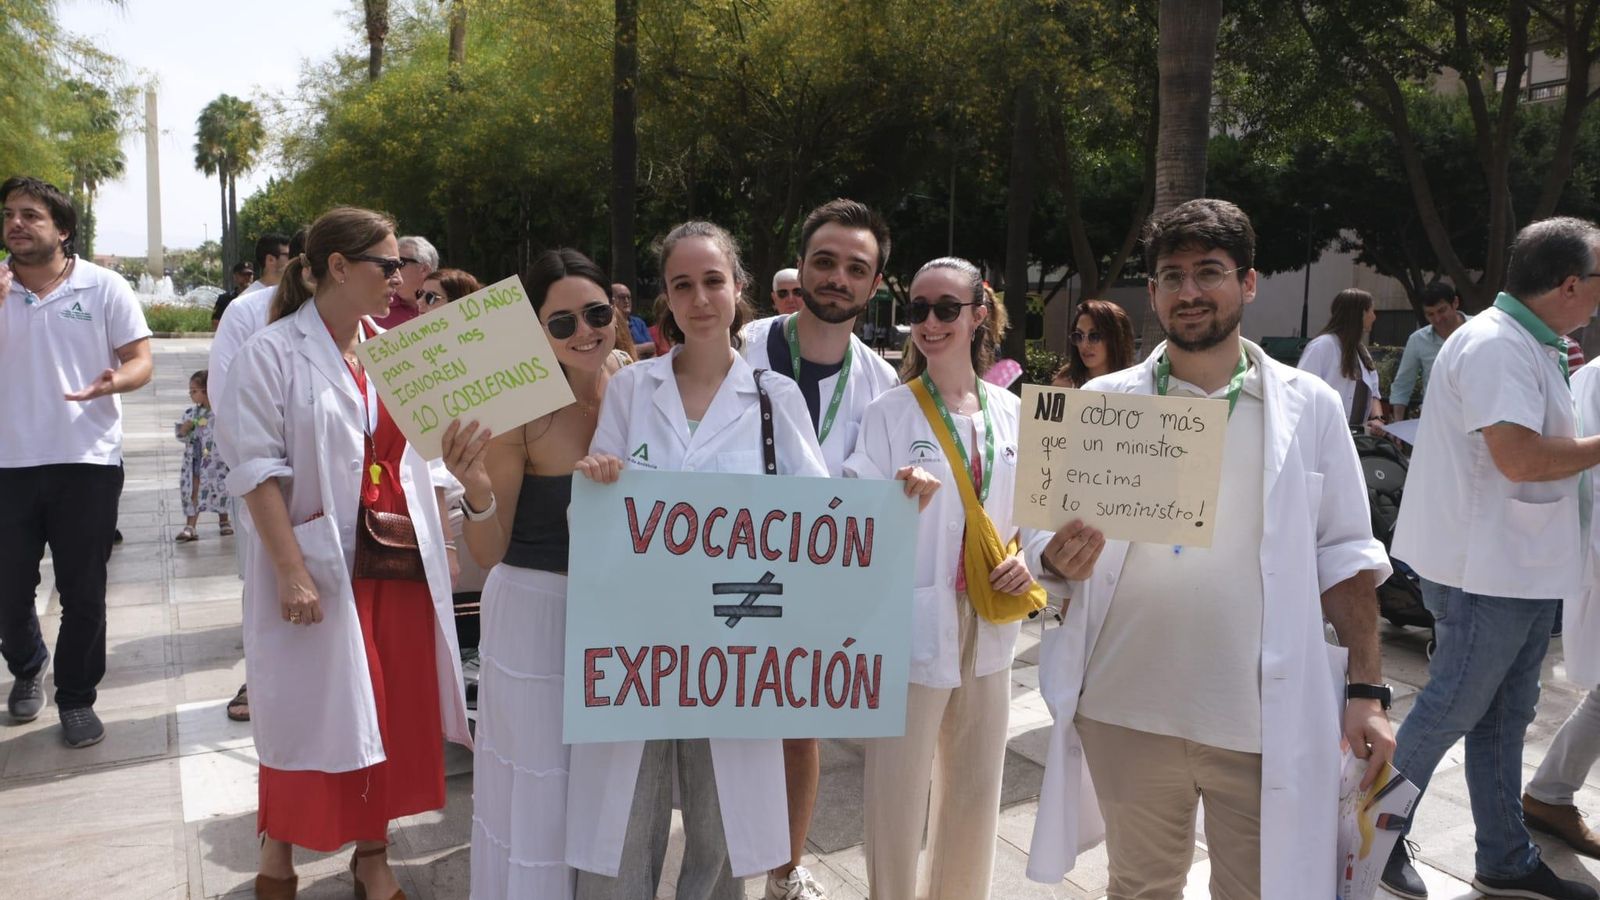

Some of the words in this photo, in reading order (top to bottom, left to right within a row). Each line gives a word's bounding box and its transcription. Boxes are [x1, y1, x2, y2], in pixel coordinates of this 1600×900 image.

[366, 318, 449, 364] Estudiamos
[458, 298, 481, 322] 10
[483, 286, 522, 314] AÑOS
[382, 359, 415, 385] para
[422, 343, 448, 366] que
[457, 328, 485, 345] nos
[392, 358, 468, 406] IGNOREN
[412, 405, 439, 434] 10
[443, 357, 549, 418] GOBIERNOS
[1034, 392, 1065, 422] NO
[1080, 394, 1144, 429] cobro
[1160, 407, 1205, 432] más
[1041, 436, 1067, 461] que
[1084, 440, 1103, 451] un
[1116, 435, 1188, 458] ministro
[1041, 467, 1052, 490] y
[1066, 468, 1141, 487] encima
[624, 496, 874, 568] VOCACIÓN
[1031, 493, 1047, 506] se
[1062, 493, 1080, 511] lo
[1096, 500, 1205, 527] suministro!
[584, 637, 882, 709] EXPLOTACIÓN
